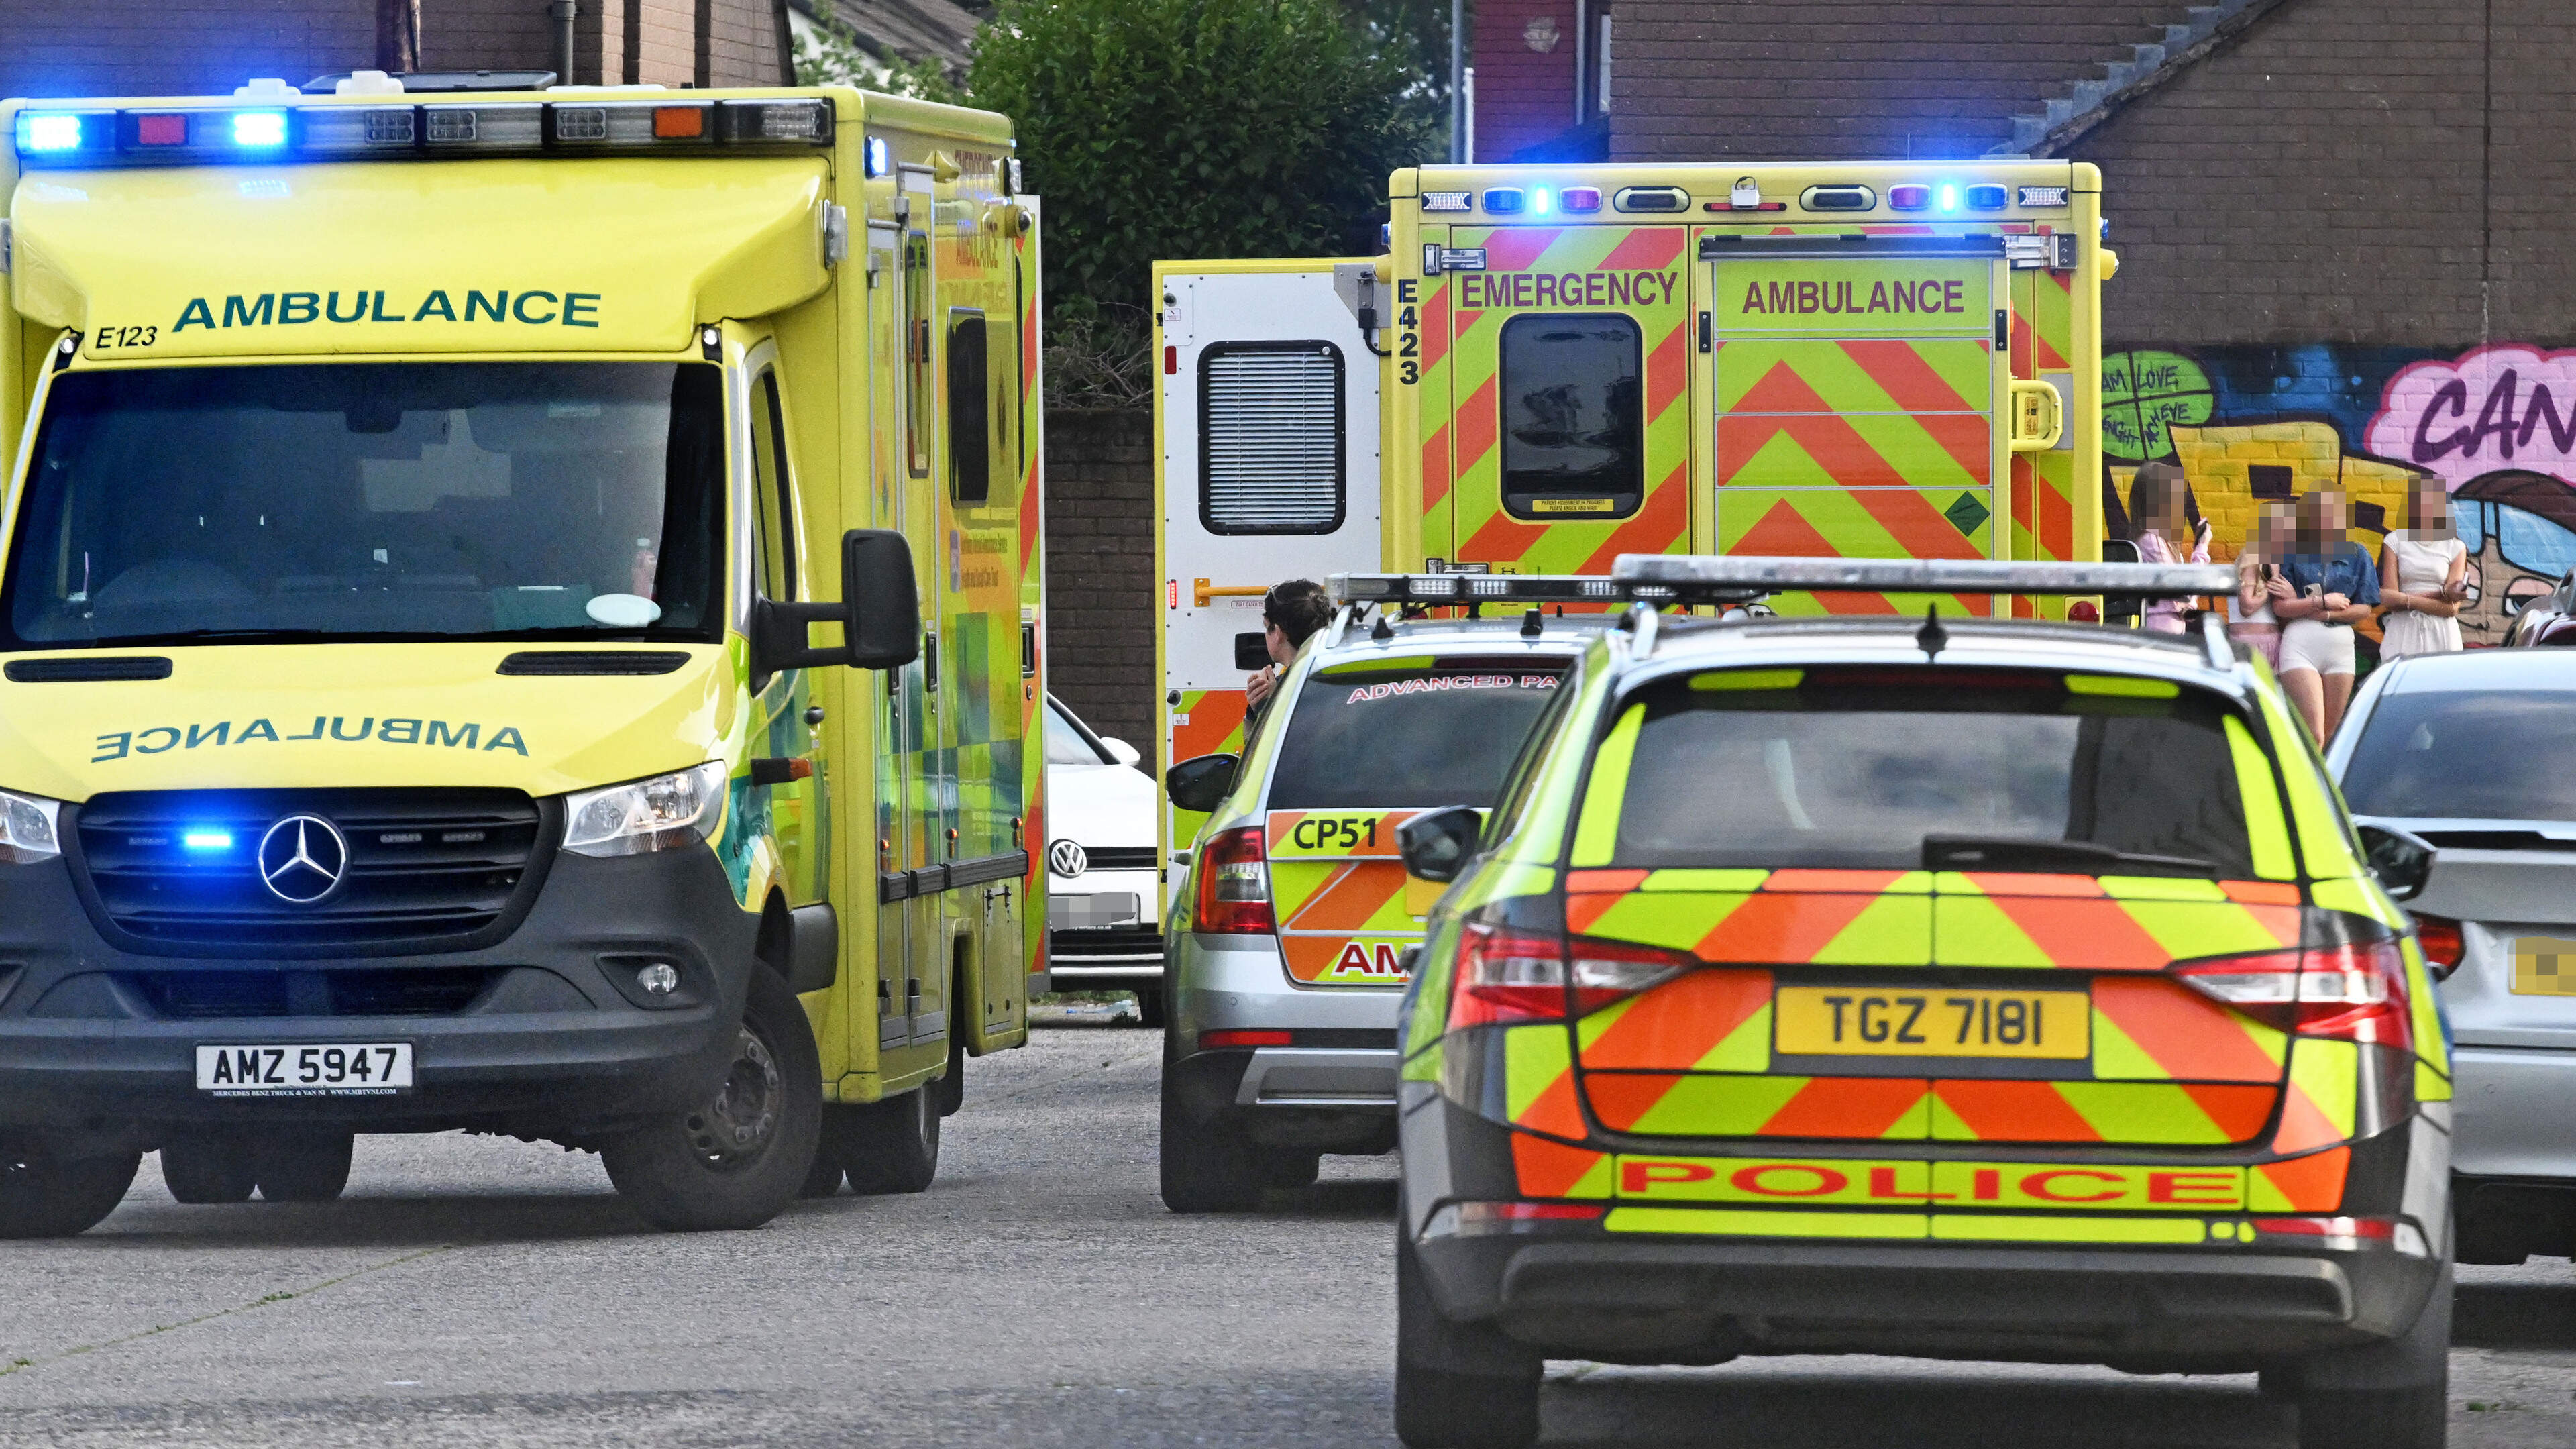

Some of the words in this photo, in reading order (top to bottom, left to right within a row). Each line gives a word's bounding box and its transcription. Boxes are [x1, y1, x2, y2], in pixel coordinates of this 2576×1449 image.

[1462, 272, 1678, 307] EMERGENCY
[1741, 280, 1965, 314] AMBULANCE
[172, 290, 602, 333] AMBULANCE
[95, 325, 159, 350] E123
[1398, 278, 1419, 385] E423
[2136, 363, 2179, 390] LOVE
[2412, 368, 2576, 463] CAN
[1347, 675, 1513, 704] ADVANCED
[1294, 818, 1377, 849] CP51
[1823, 997, 1927, 1043] TGZ
[1945, 998, 2042, 1046] 7181
[213, 1049, 285, 1084] AMZ
[298, 1048, 397, 1083] 5947
[1620, 1161, 2240, 1204] POLICE
